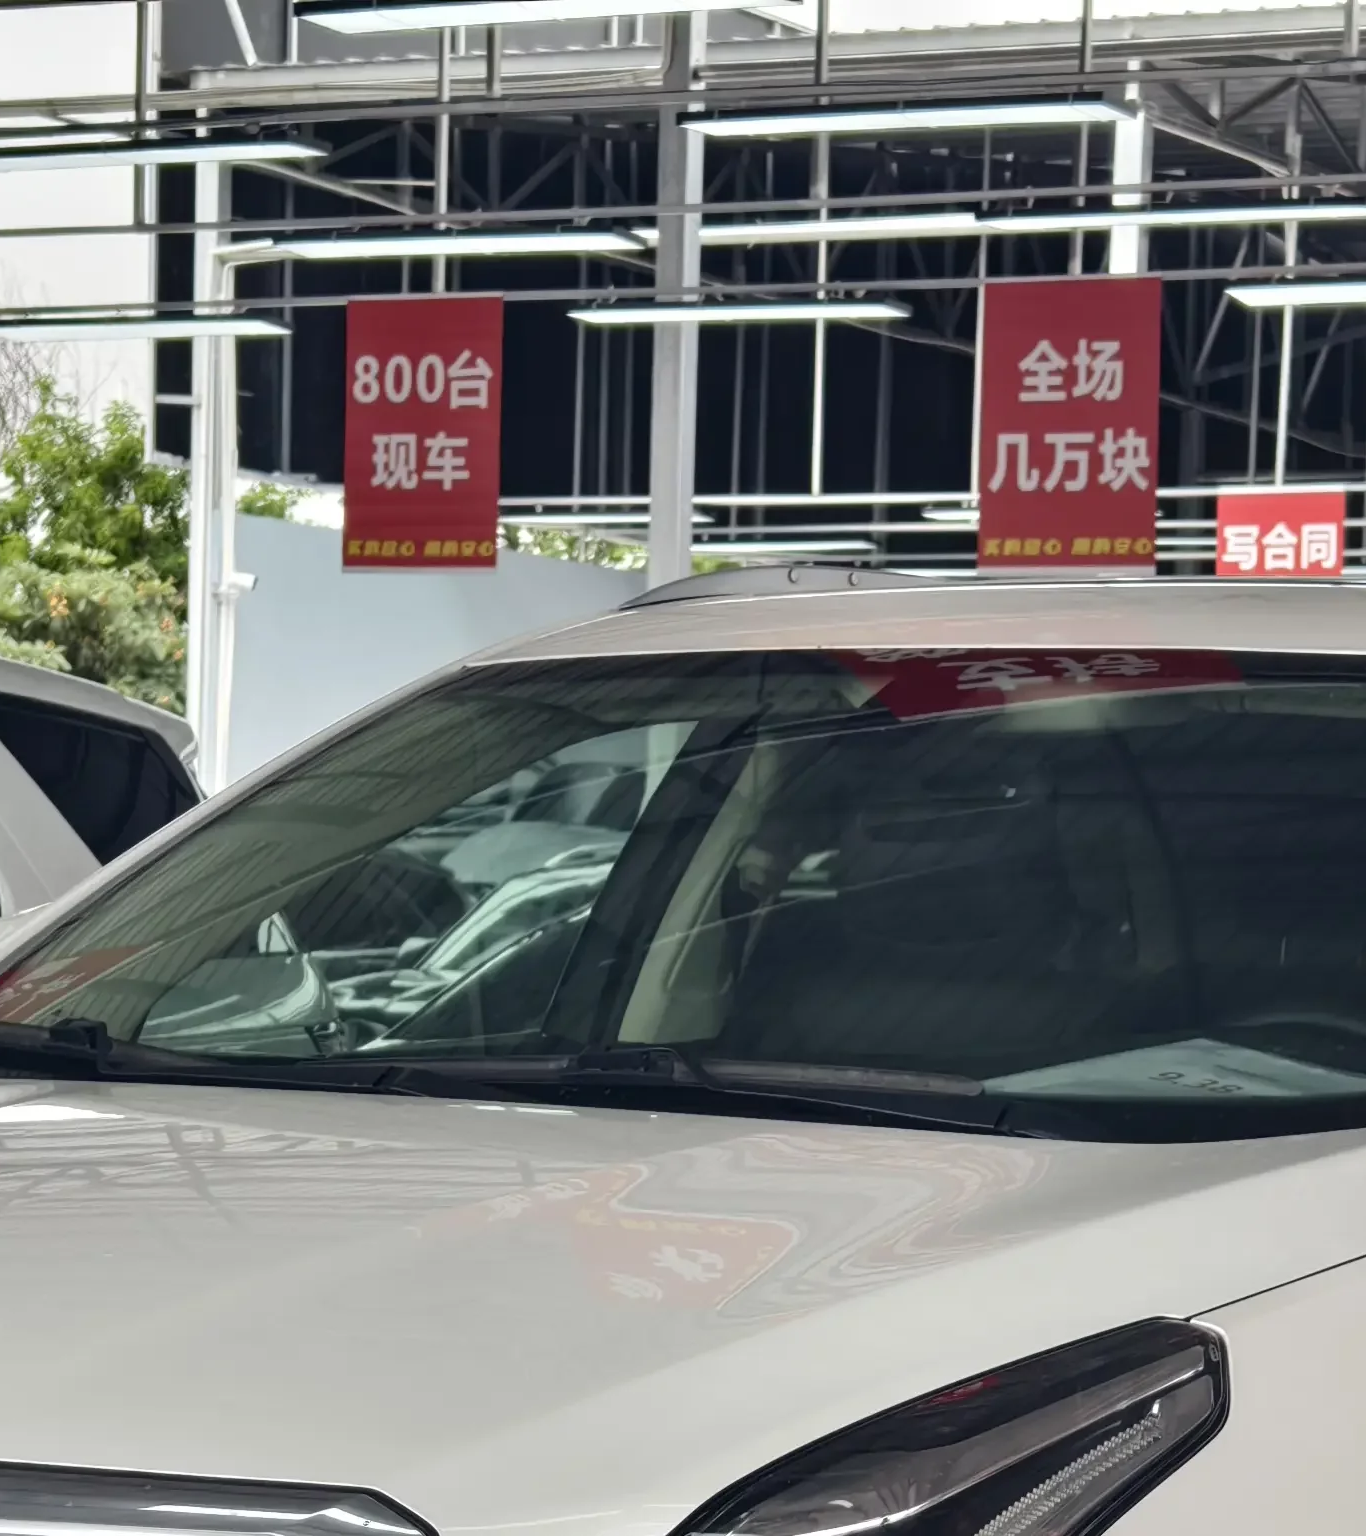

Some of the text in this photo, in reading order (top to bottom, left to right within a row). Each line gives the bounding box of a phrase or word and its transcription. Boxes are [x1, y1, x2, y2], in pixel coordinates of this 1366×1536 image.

[352, 349, 493, 410] 800台
[1018, 338, 1124, 402] 全场
[371, 431, 470, 491] 现车
[988, 427, 1151, 497] 几万块
[1221, 521, 1339, 571] 写合同
